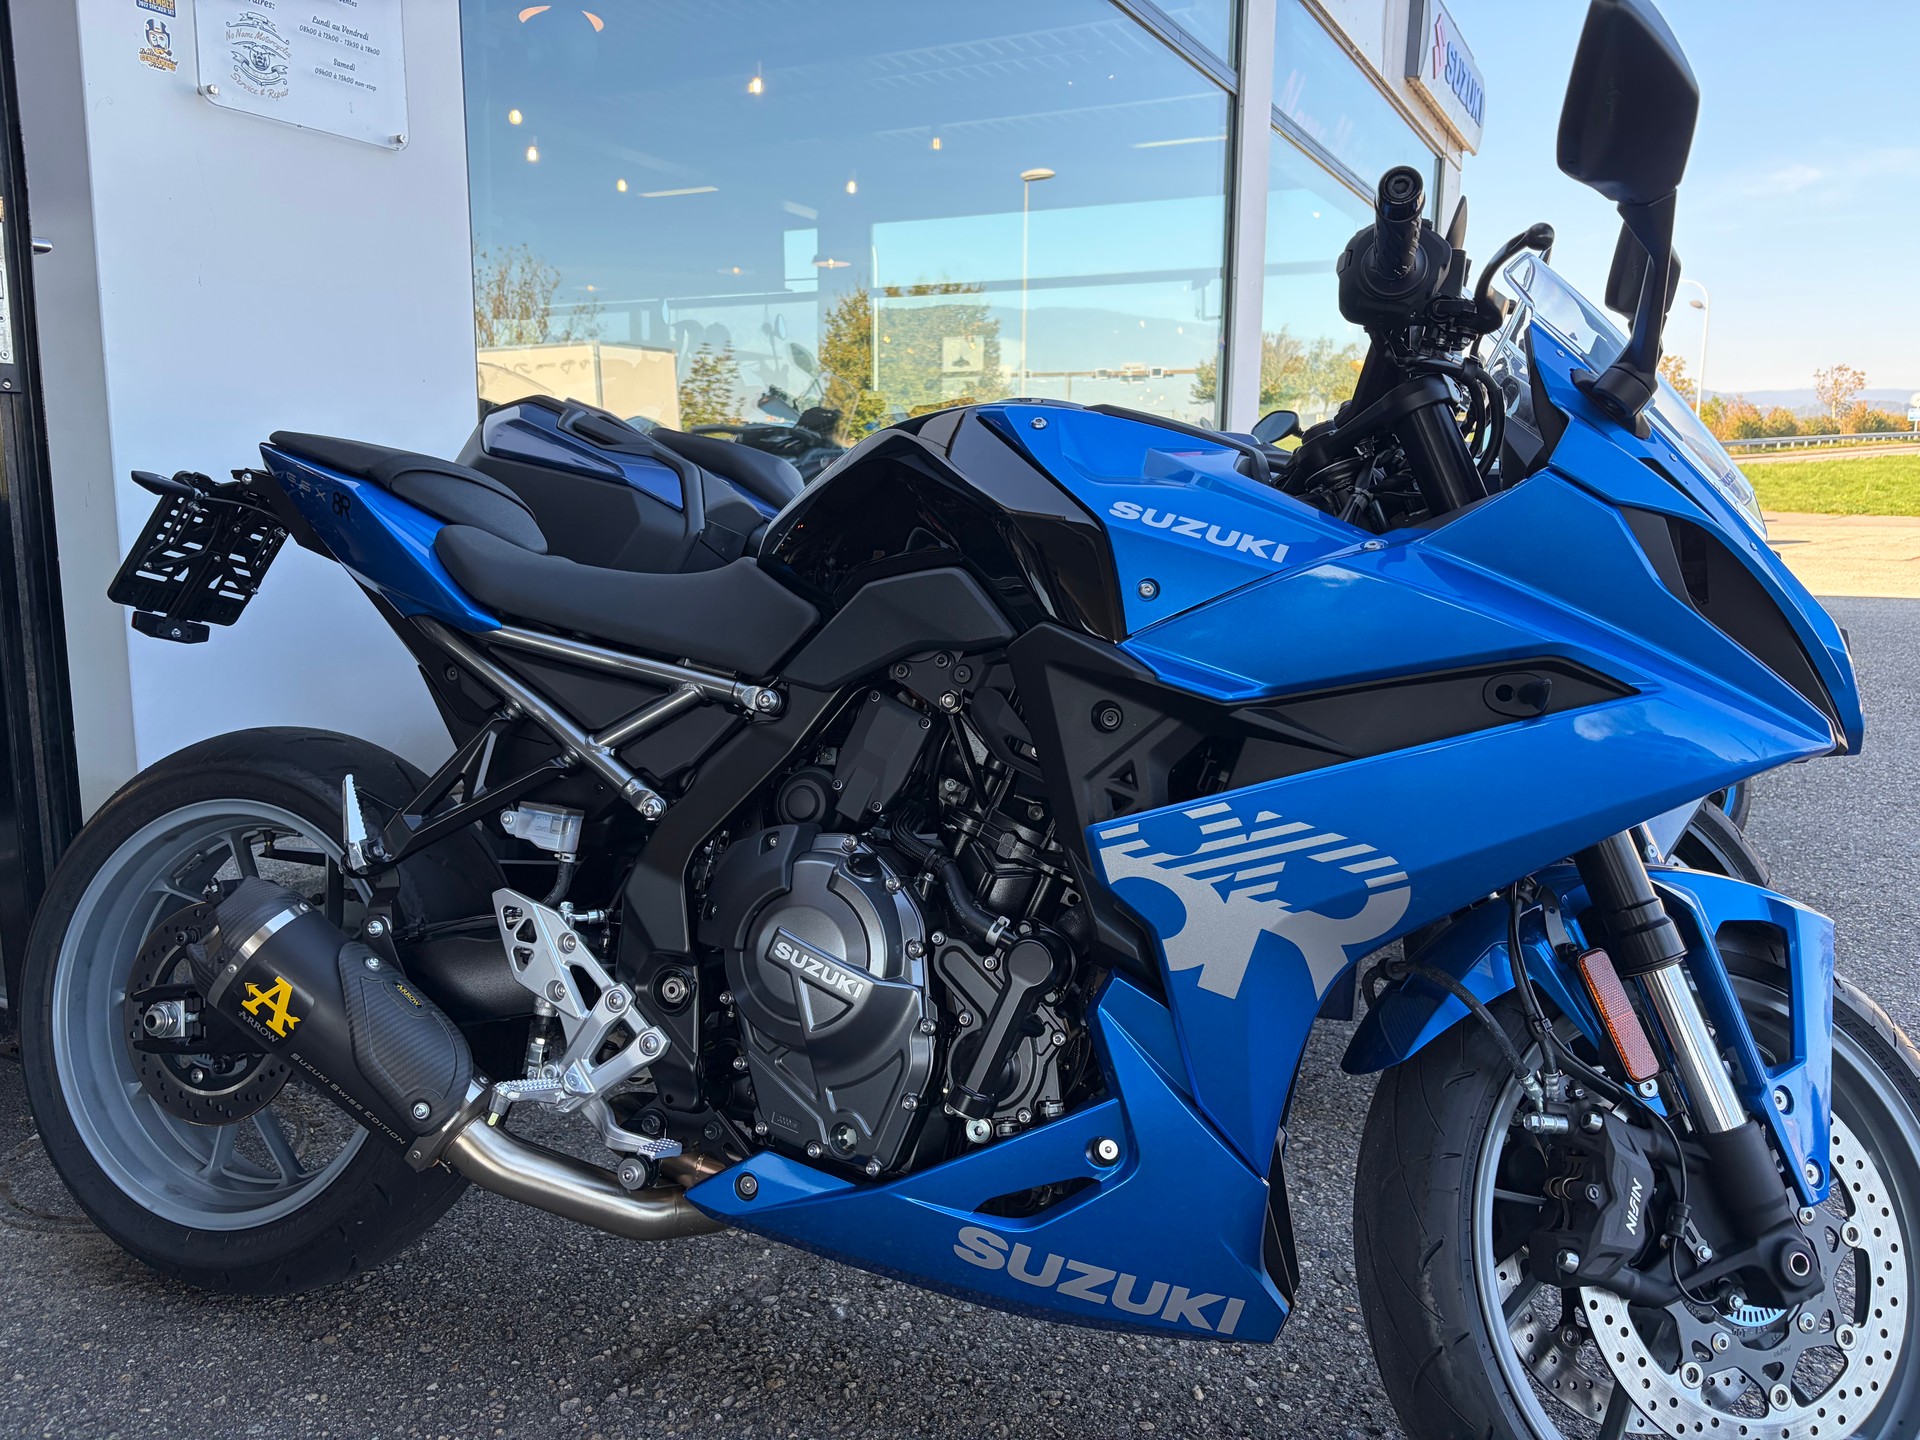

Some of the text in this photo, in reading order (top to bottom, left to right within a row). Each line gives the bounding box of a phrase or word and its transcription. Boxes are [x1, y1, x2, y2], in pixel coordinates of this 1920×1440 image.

[226, 28, 292, 58] No Name Motorcycles
[299, 24, 317, 36] 08h00
[323, 32, 340, 43] 12h00
[312, 15, 331, 28] Lundi
[341, 24, 369, 41] Vendredi
[314, 67, 333, 78] 09h00
[355, 80, 377, 92] non-stop
[333, 58, 356, 72] Samedi
[230, 72, 258, 96] Service
[267, 88, 289, 102] Repair
[1444, 40, 1484, 129] SUZUKI
[1108, 501, 1290, 564] SUZUKI
[774, 941, 864, 999] SUZUKI
[396, 983, 421, 1007] ARROW
[238, 1010, 279, 1043] ARROW
[290, 1052, 330, 1084] SUZUKI
[953, 1226, 1246, 1335] SUZUKI
